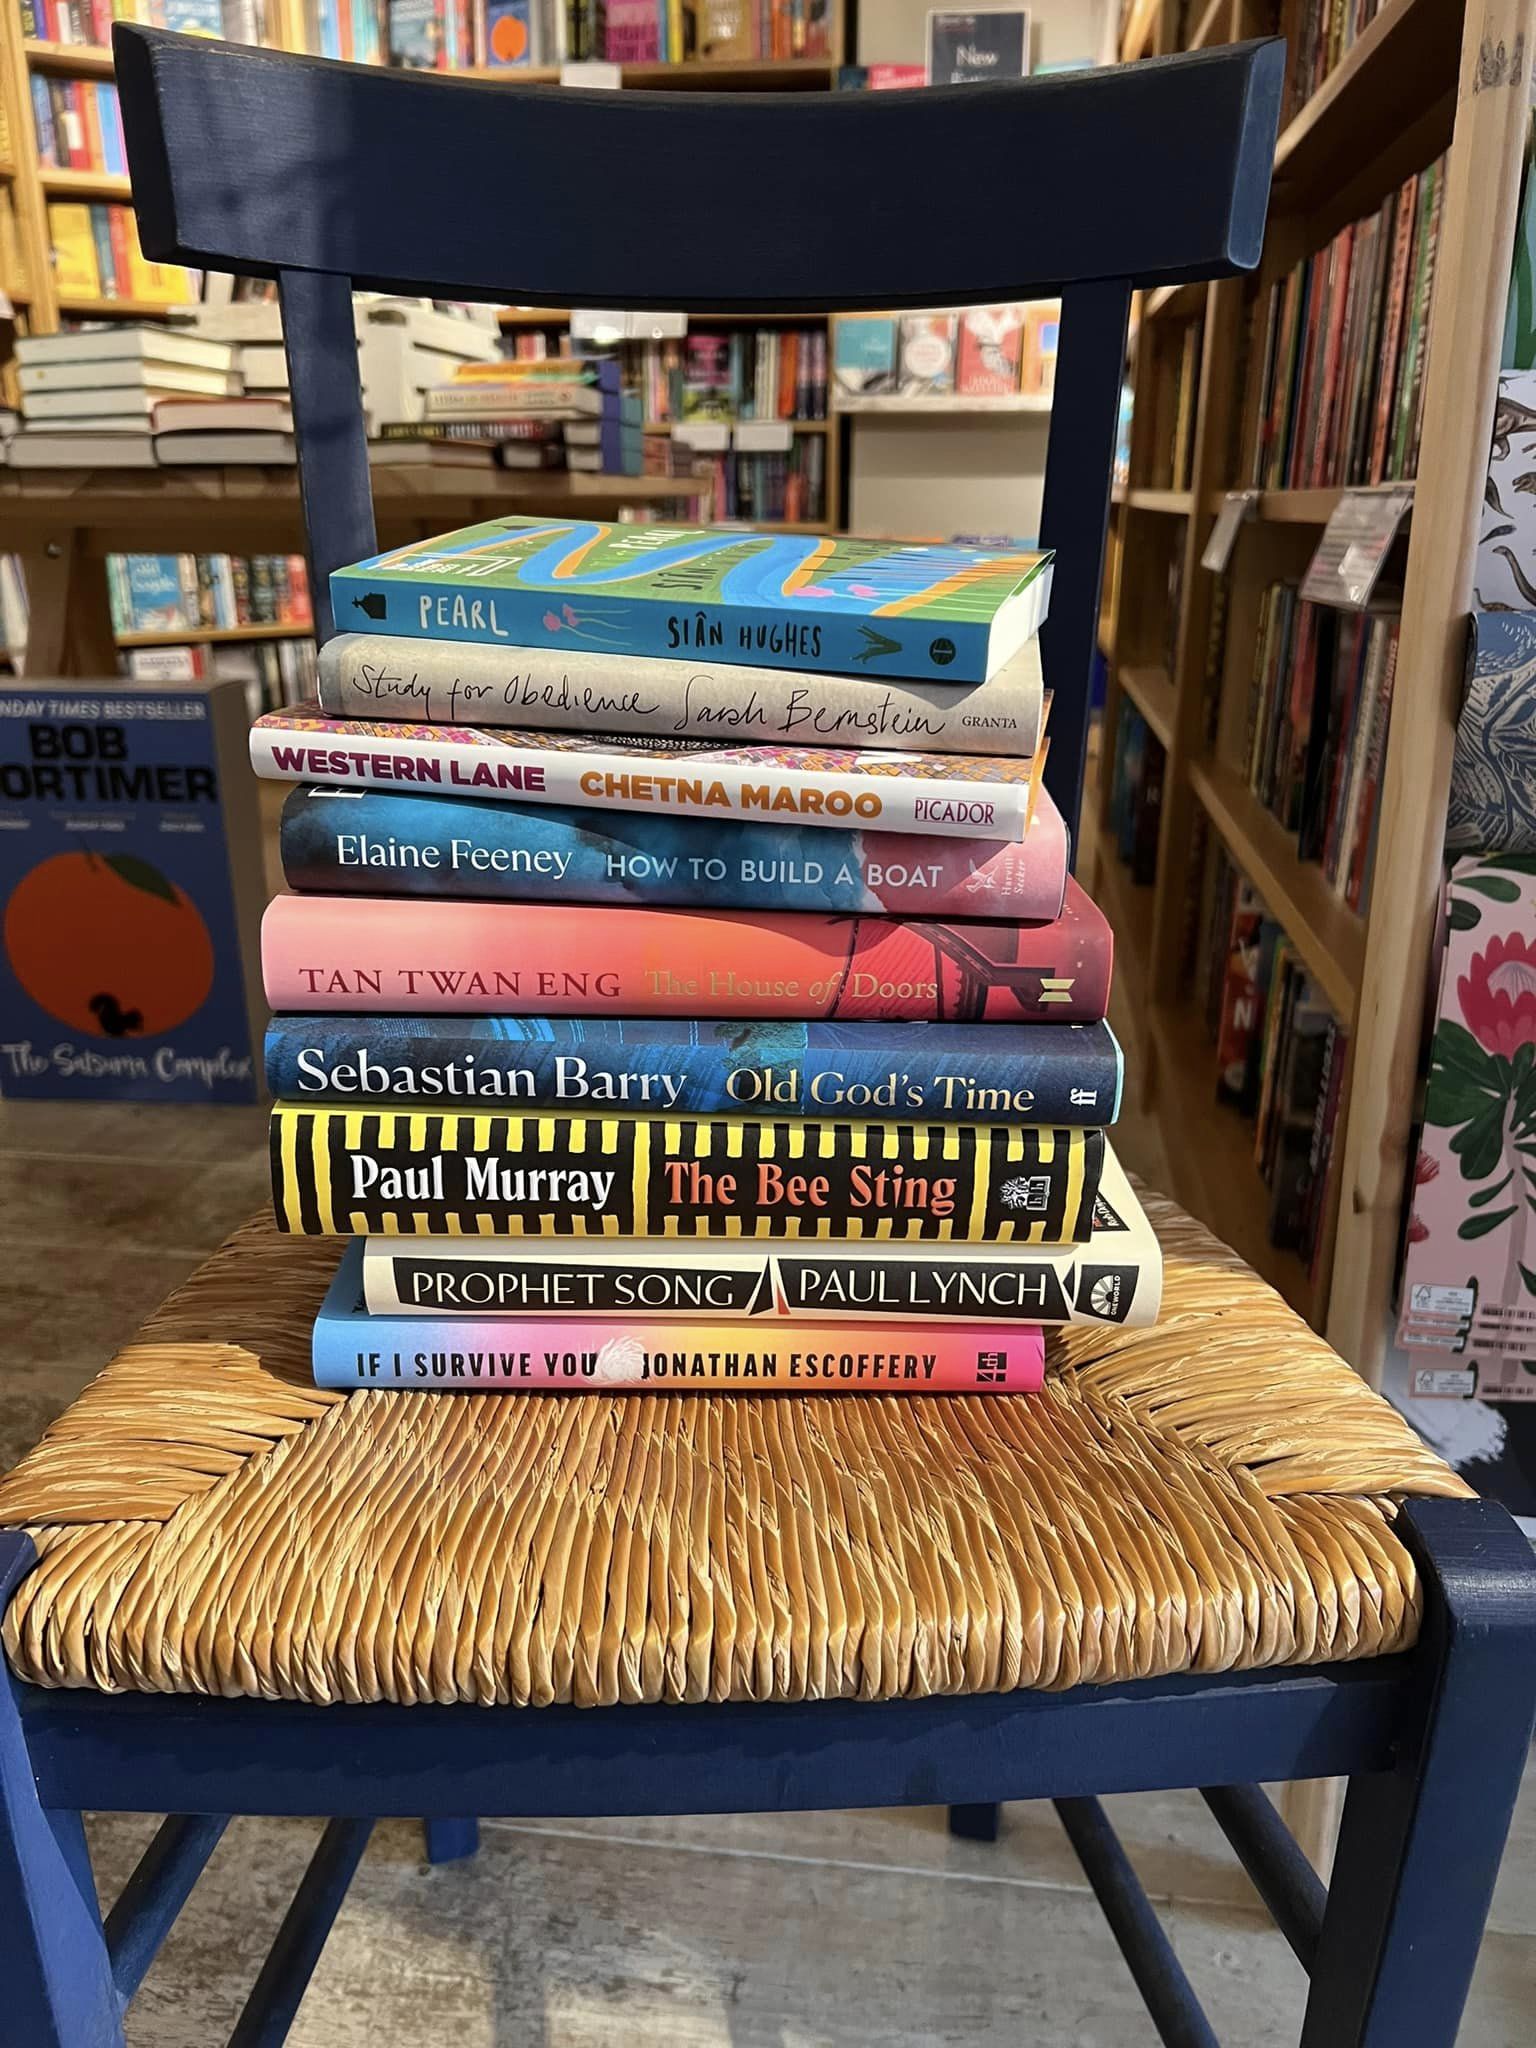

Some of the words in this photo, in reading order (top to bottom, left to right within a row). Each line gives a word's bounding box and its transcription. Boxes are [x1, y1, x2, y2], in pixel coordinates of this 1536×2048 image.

[419, 594, 509, 637] PEARL
[668, 611, 723, 649] SIÂN
[739, 620, 821, 657] HUGHES
[49, 700, 100, 719] TIMES
[104, 701, 205, 721] BESTSELLER
[353, 664, 431, 721] Study
[447, 677, 493, 720] for
[504, 672, 660, 715] Obedience
[674, 674, 767, 730] Sarah
[777, 689, 946, 736] Bernstein
[962, 715, 1017, 730] GRANTA
[29, 723, 128, 761] BOB
[0, 763, 217, 803] ORTIMER
[271, 746, 441, 783] WESTERN
[451, 760, 546, 792] LANE
[579, 771, 731, 808] CHETNA
[741, 783, 883, 819] MAROO
[915, 799, 995, 825] PICADOR
[336, 834, 440, 869] Elaine
[451, 839, 573, 880] Feeney
[606, 854, 678, 879] HOW
[688, 857, 727, 882] TO
[741, 859, 823, 885] BUILD
[834, 863, 854, 886] A
[868, 864, 944, 888] BOAT
[299, 968, 382, 994] TAN
[398, 970, 520, 997] TWAN
[537, 972, 620, 998] ENG
[644, 968, 697, 996] The
[709, 971, 799, 999] House
[808, 971, 843, 1005] of
[851, 973, 938, 1001] Doors
[1, 1039, 48, 1077] The
[297, 1048, 536, 1098] Sebastian
[555, 1056, 687, 1109] Barry
[726, 1067, 798, 1103] Old
[811, 1071, 924, 1107] God's
[933, 1076, 1035, 1112] Time
[350, 1154, 446, 1200] Paul
[464, 1156, 616, 1211] Murray
[664, 1161, 737, 1206] The
[756, 1163, 830, 1208] Bee
[849, 1163, 957, 1217] Sting
[413, 1272, 605, 1305] PROPHET
[614, 1274, 734, 1307] SONG
[800, 1268, 906, 1304] PAUL
[910, 1271, 1047, 1307] LYNCH
[1110, 1275, 1122, 1316] ONEWORLD
[357, 1353, 381, 1377] IF
[394, 1353, 402, 1377] I
[414, 1352, 531, 1378] SURVIVE
[543, 1352, 597, 1378] YOU
[641, 1353, 776, 1379] JONATHAN
[790, 1353, 938, 1379] ESCOFFERY
